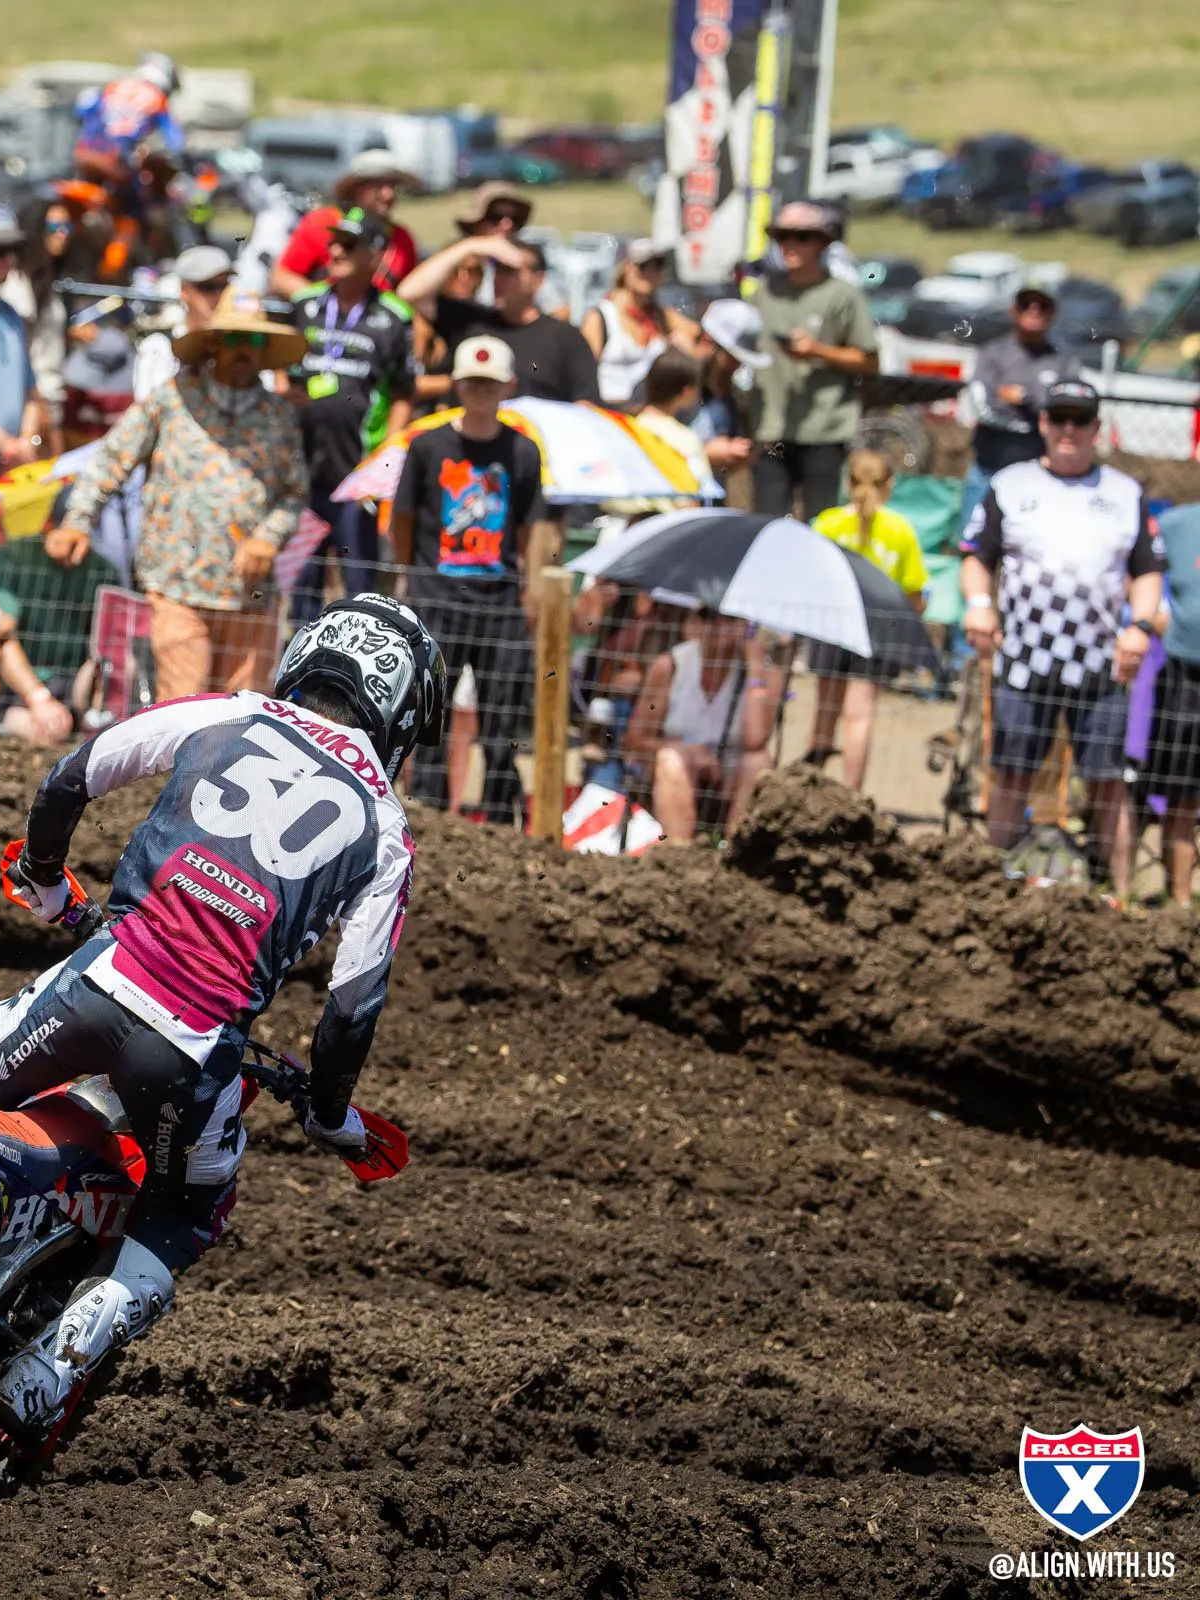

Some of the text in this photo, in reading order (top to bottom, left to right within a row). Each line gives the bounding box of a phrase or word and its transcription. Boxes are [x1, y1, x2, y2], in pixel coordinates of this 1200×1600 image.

[190, 721, 367, 880] 30
[167, 872, 257, 929] PROGRESSIVE
[182, 849, 267, 913] HONDA
[6, 1016, 64, 1070] HONDA
[155, 1120, 173, 1175] HONDA
